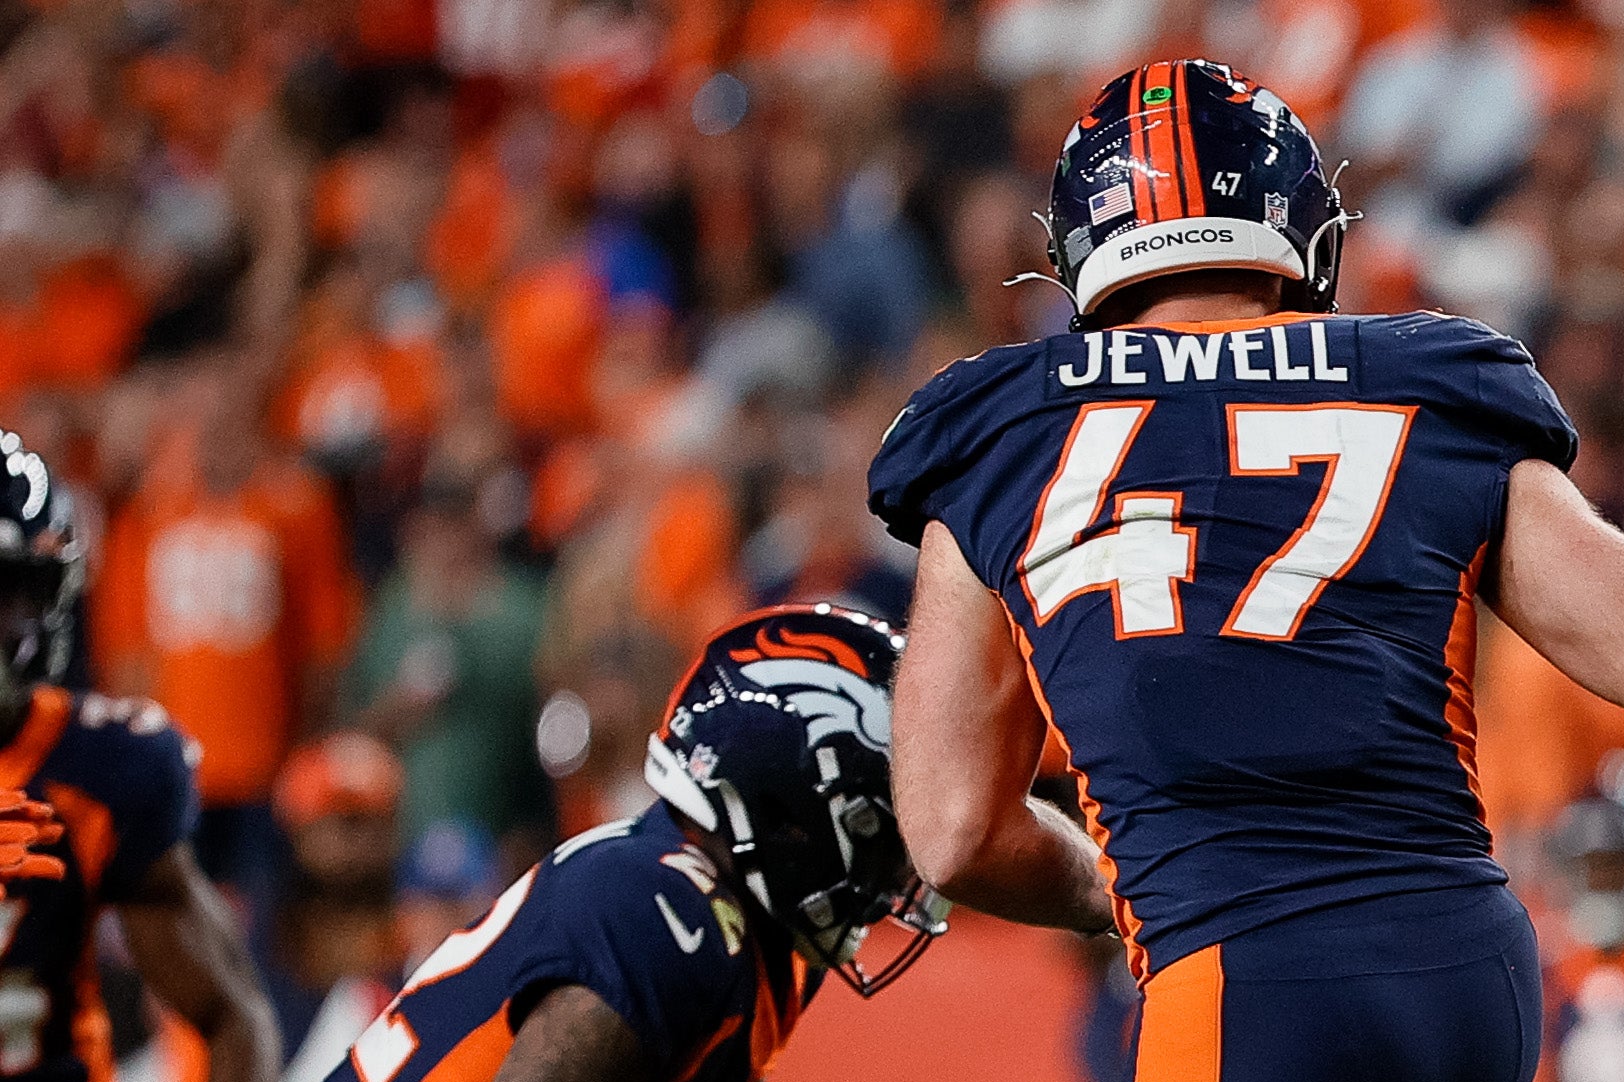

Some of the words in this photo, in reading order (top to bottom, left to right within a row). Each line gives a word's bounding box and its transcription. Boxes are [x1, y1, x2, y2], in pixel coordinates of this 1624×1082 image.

[1211, 171, 1242, 197] 47
[1120, 229, 1234, 262] BRONCOS
[1058, 321, 1349, 387] JEWELL
[1017, 400, 1420, 642] 47
